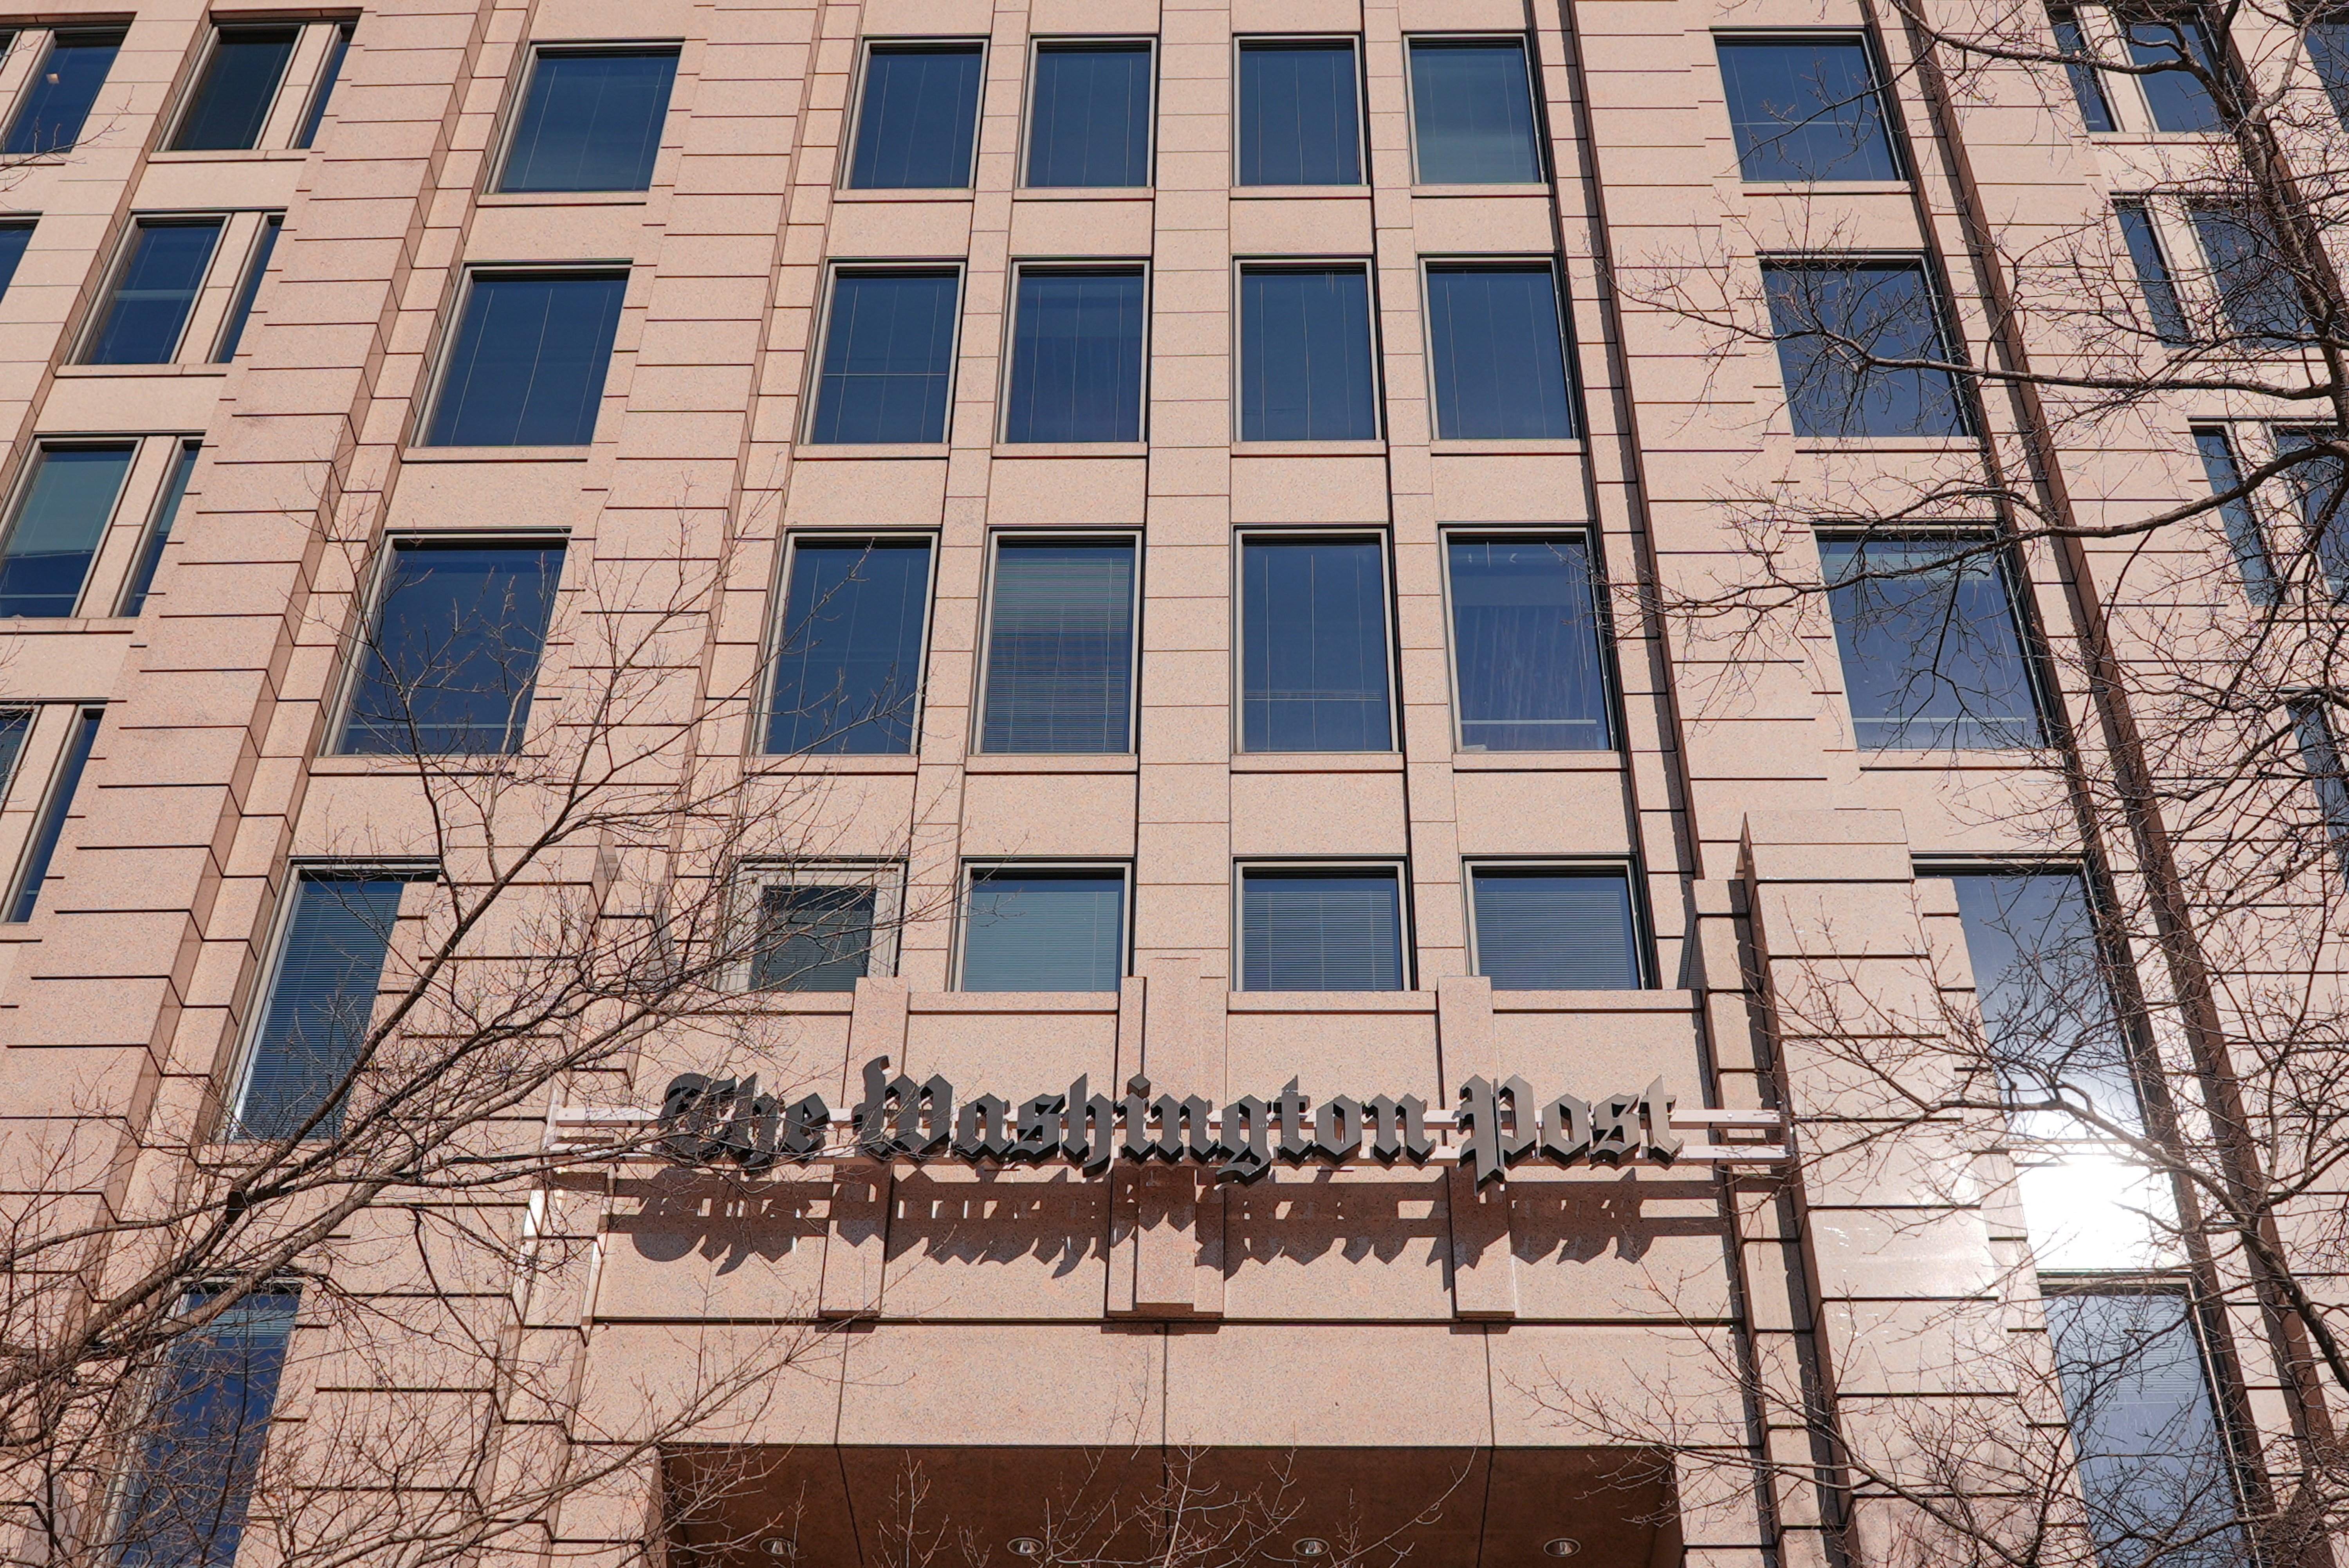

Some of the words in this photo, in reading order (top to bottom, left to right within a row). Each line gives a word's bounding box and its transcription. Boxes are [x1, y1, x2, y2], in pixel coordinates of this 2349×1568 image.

[660, 1072, 830, 1170] The
[852, 1055, 1436, 1184] Washington
[1457, 1074, 1683, 1194] Post
